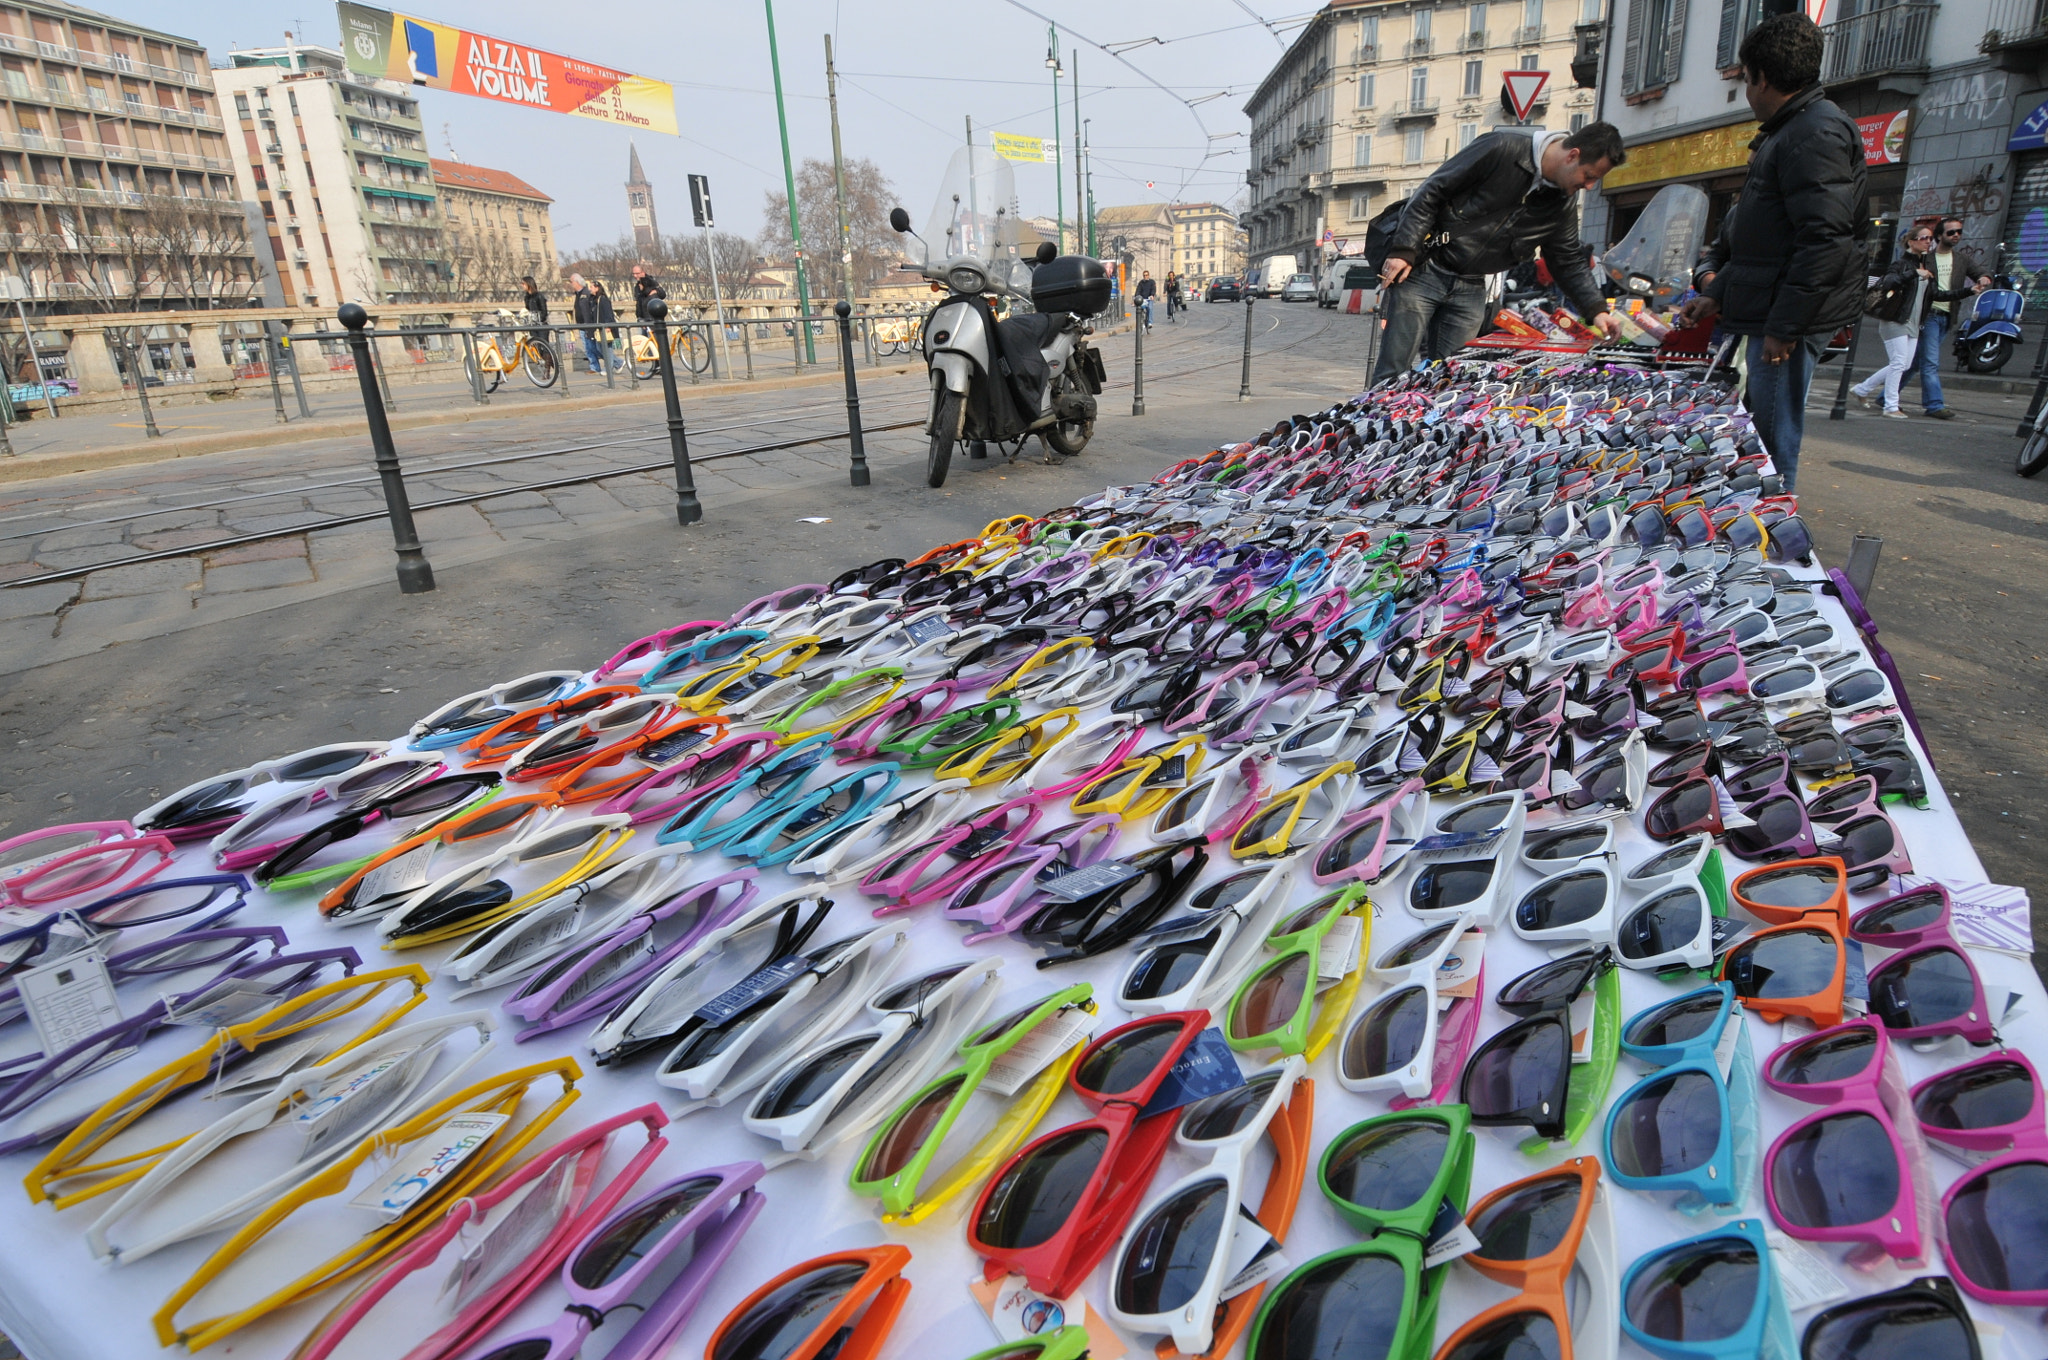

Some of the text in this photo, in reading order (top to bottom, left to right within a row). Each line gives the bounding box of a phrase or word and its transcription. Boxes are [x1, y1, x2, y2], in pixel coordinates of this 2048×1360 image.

[349, 18, 373, 30] Milano
[467, 35, 548, 81] ALZA IL
[563, 61, 573, 69] SE
[465, 64, 552, 107] VOLUME
[564, 72, 622, 97] Giornate 20
[584, 90, 622, 109] della 21
[577, 101, 650, 126] Lettura 22 Marzo
[1858, 121, 1884, 133] urger
